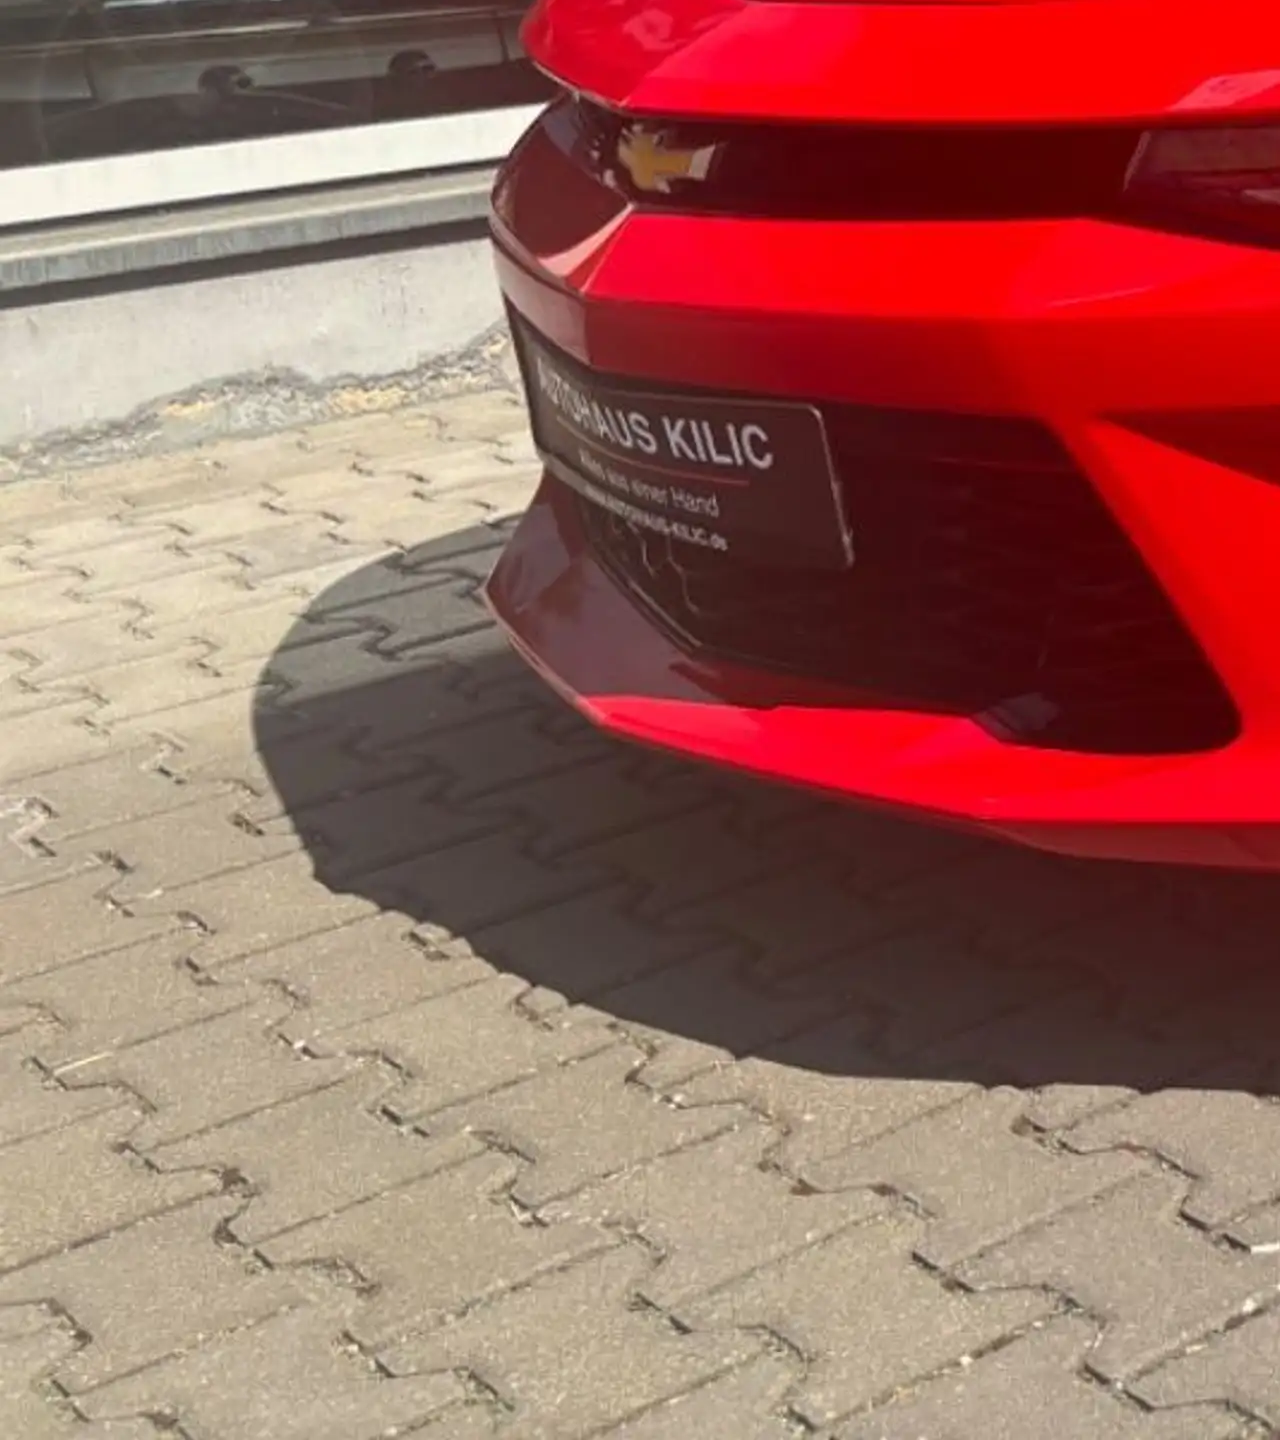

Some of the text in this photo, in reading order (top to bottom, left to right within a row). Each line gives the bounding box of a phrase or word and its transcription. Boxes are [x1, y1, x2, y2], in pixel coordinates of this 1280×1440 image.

[537, 357, 774, 470] AUTOHAUS KILIC
[669, 485, 720, 518] Hand
